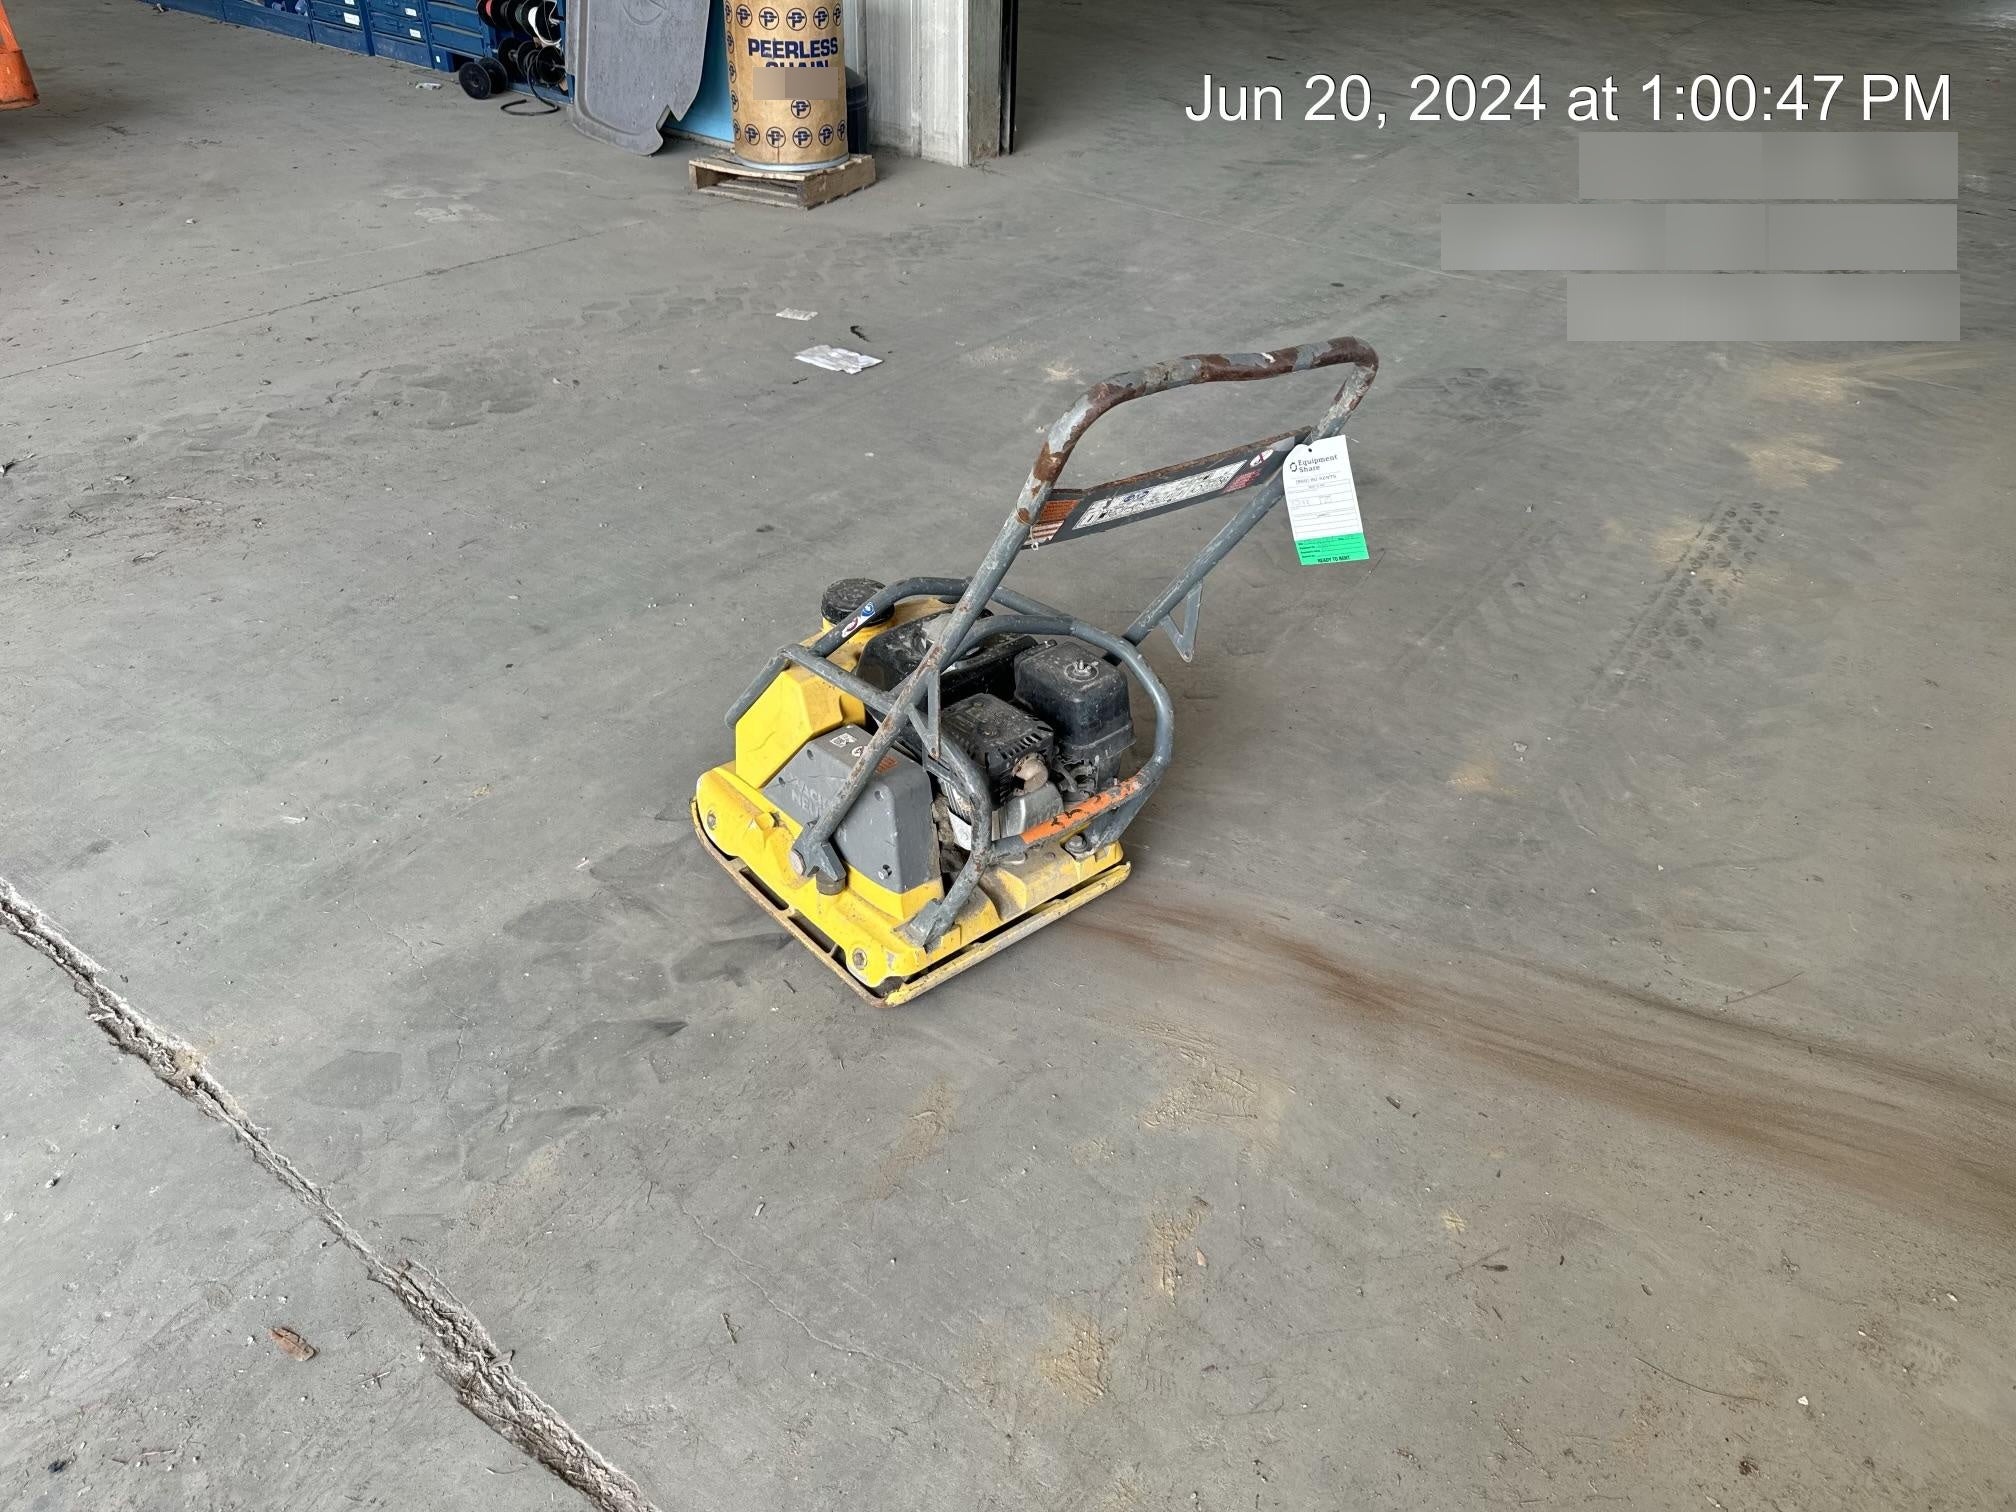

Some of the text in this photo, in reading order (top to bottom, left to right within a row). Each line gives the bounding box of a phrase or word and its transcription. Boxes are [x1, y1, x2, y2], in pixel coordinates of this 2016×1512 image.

[748, 37, 838, 59] PEERLESS
[1298, 454, 1338, 466] Equipment
[1298, 465, 1320, 473] Share
